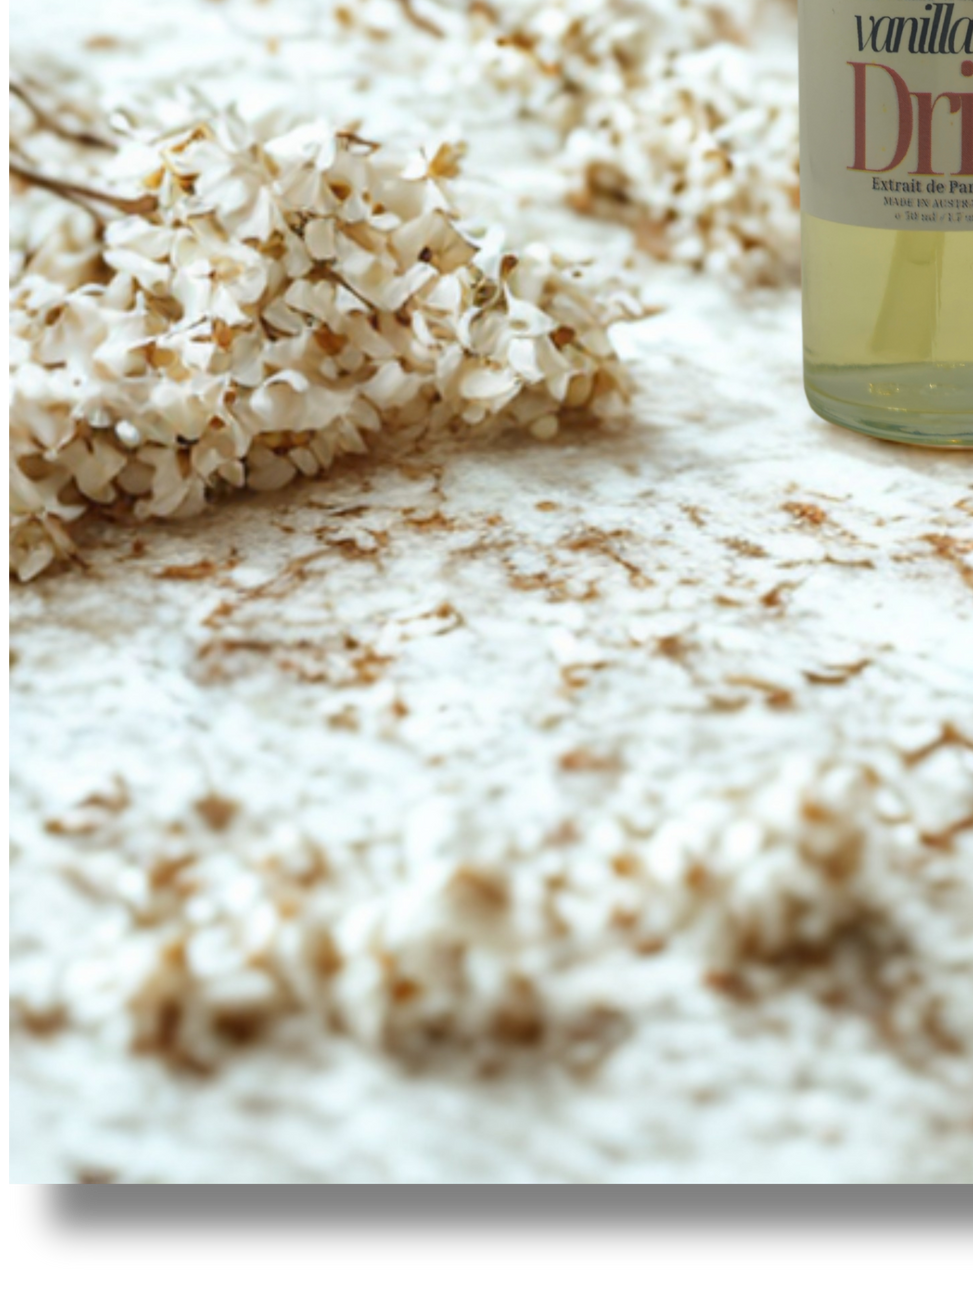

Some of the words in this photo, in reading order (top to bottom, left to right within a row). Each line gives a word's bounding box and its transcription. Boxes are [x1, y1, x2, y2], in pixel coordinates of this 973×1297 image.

[872, 177, 922, 193] Extrait
[926, 179, 945, 194] de
[884, 196, 912, 208] MADE
[917, 198, 929, 208] IN
[921, 212, 936, 222] ml
